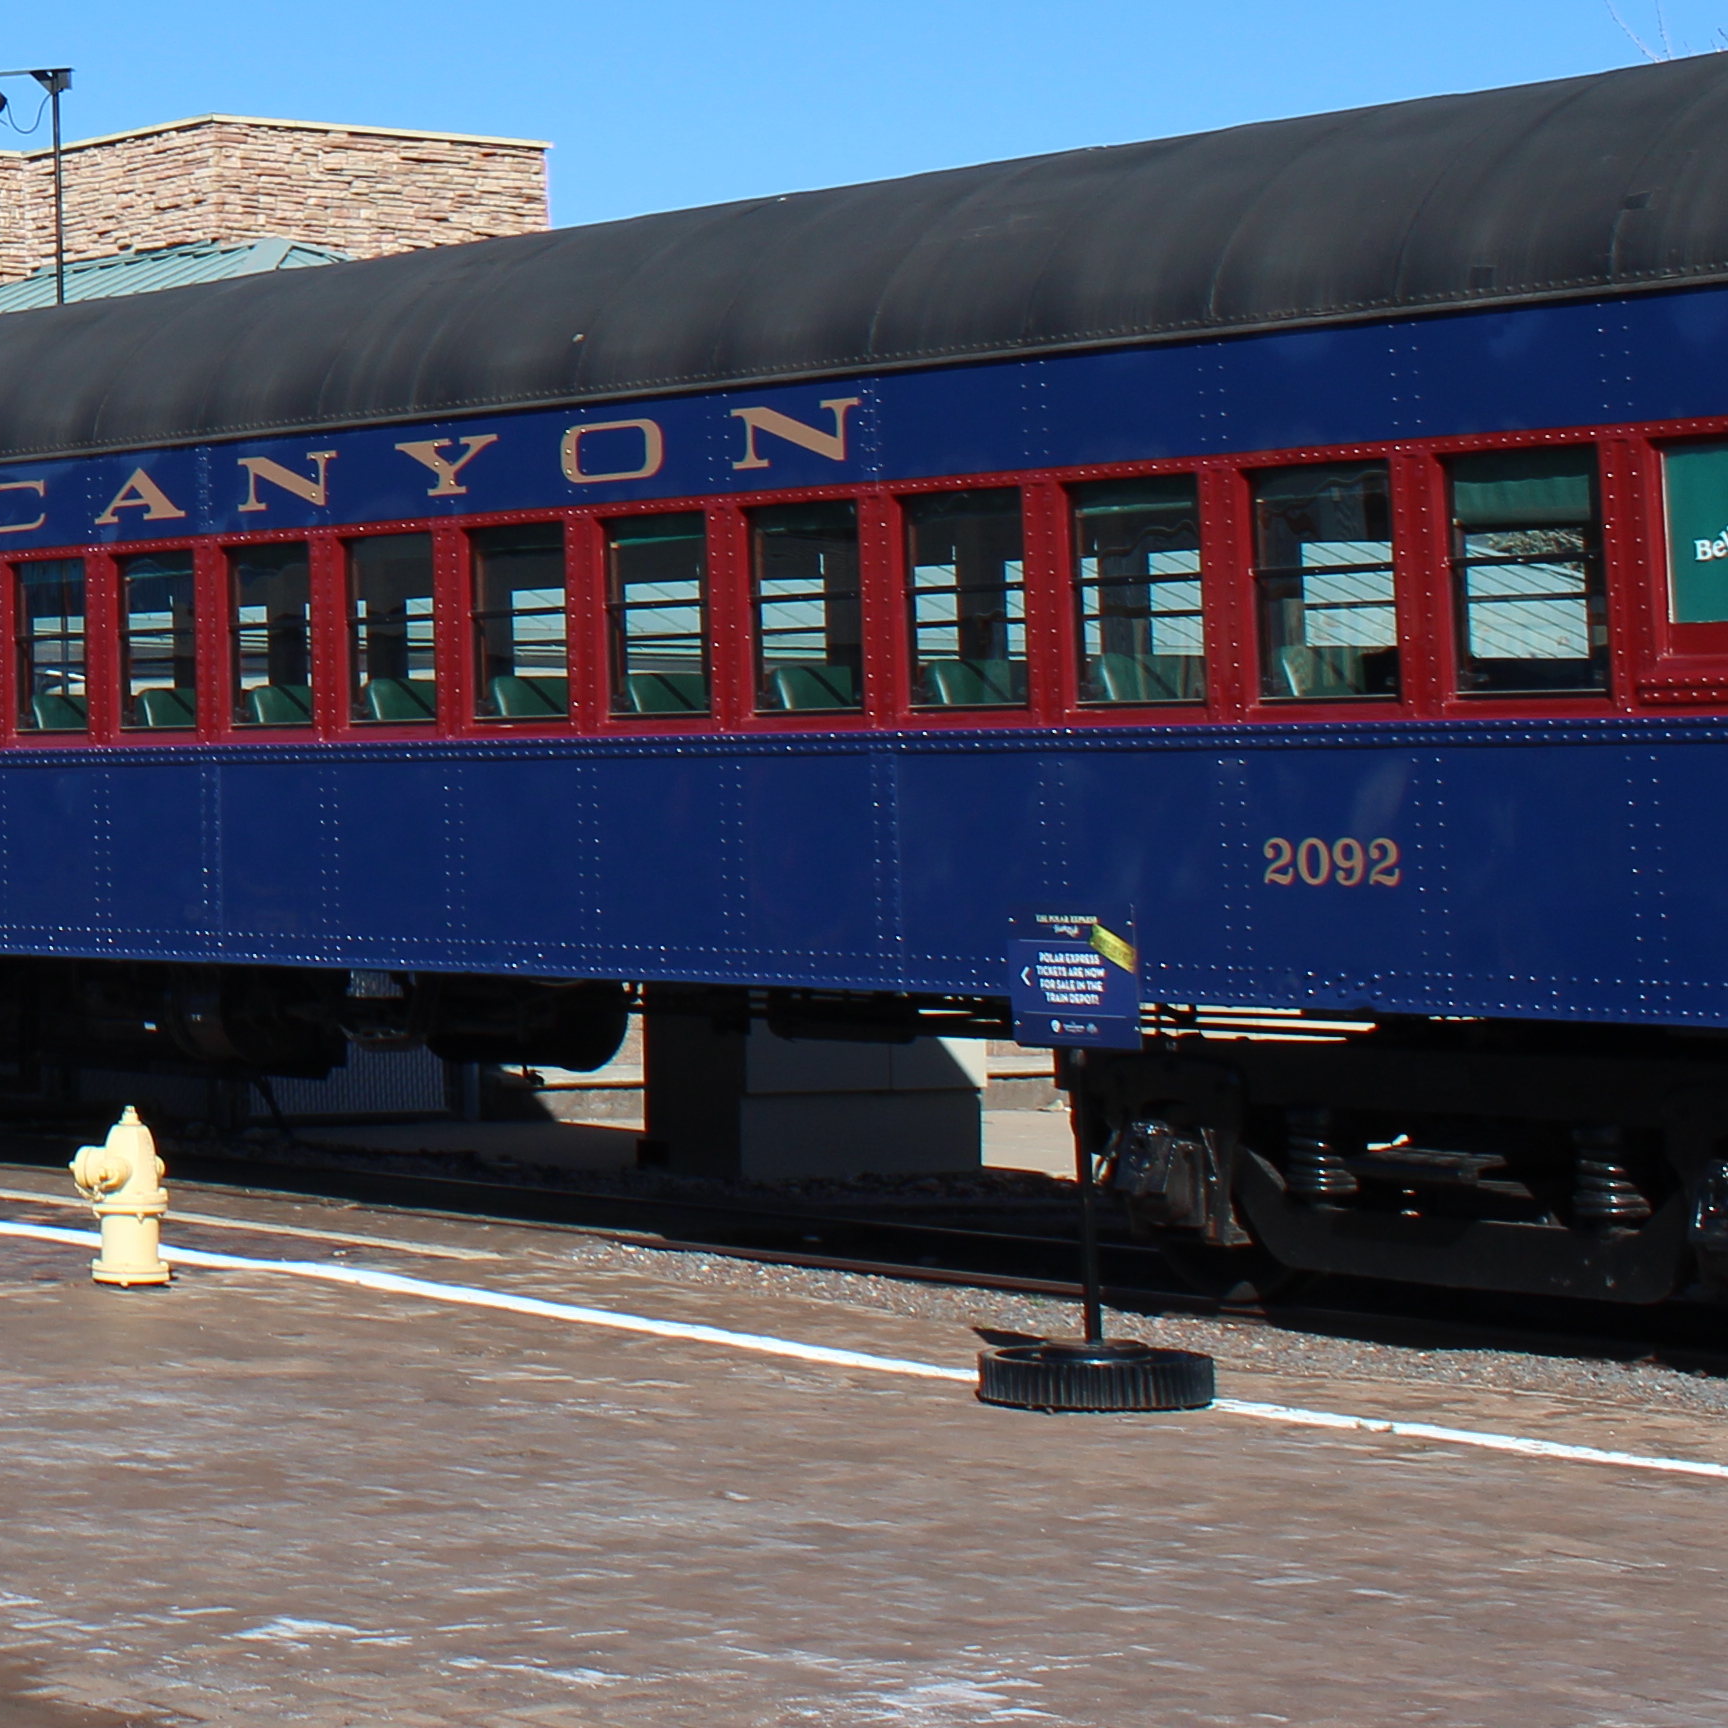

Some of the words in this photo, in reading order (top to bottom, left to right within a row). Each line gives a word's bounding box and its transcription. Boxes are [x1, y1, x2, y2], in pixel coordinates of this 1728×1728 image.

[1263, 836, 1402, 888] 2092
[1038, 952, 1065, 964] POLAR
[1065, 953, 1101, 965] EXPRESS
[1035, 964, 1068, 977] TICKETS
[1068, 966, 1084, 978] ARE
[1084, 967, 1107, 979] NOW
[1039, 978, 1055, 990] FOR
[1056, 979, 1076, 991] SALE
[1086, 980, 1104, 992] THE
[1045, 991, 1069, 1004] TRAIN
